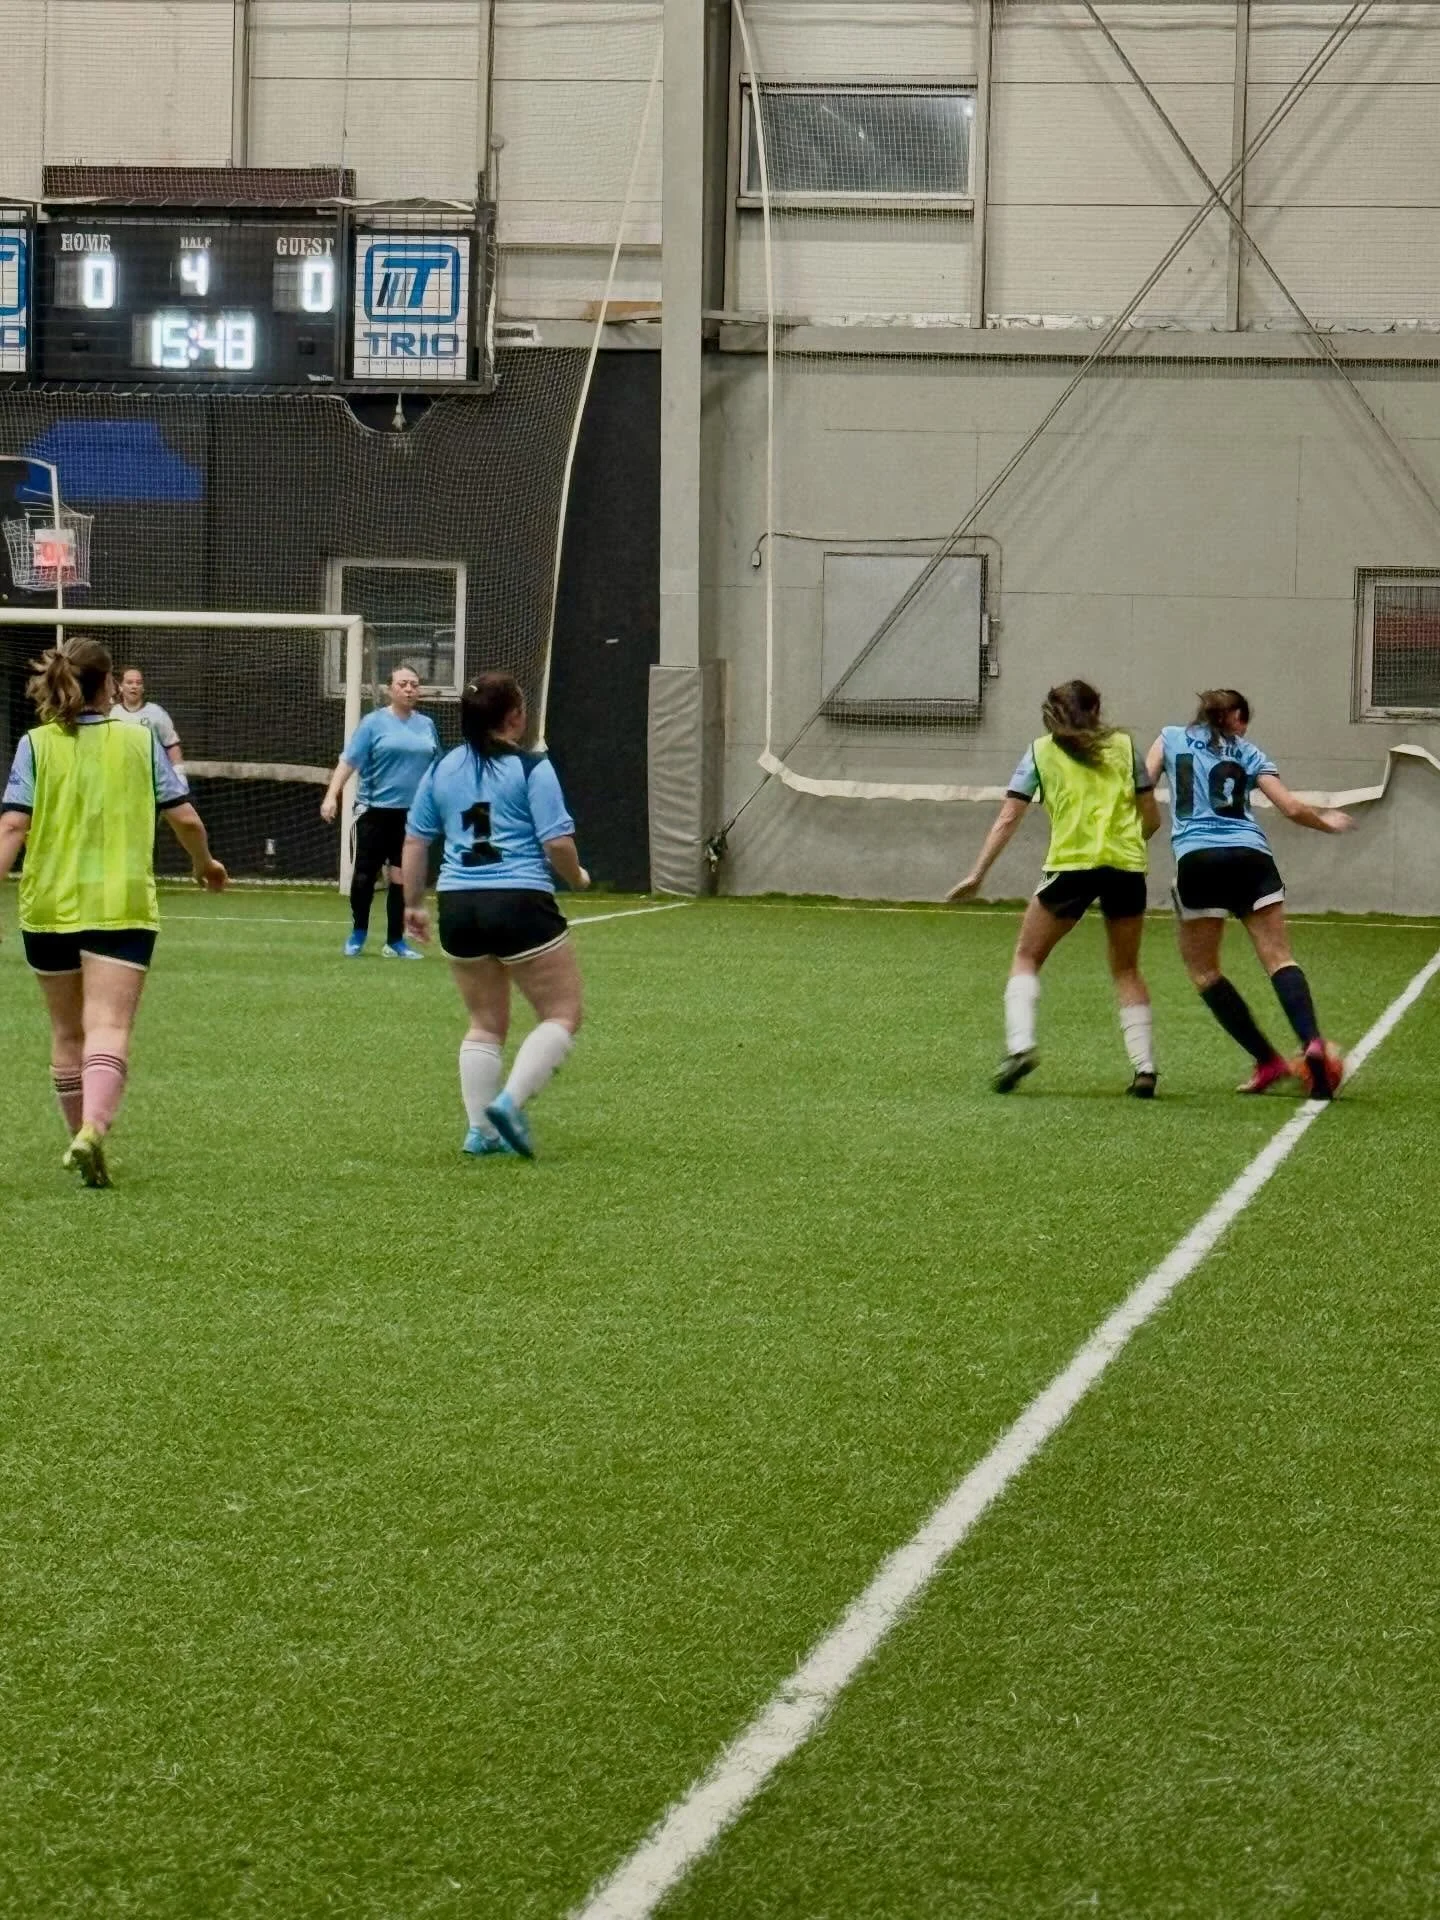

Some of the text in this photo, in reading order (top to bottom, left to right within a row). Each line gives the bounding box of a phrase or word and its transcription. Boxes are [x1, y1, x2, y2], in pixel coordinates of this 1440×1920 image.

[60, 233, 111, 252] HOME
[180, 236, 211, 249] HALF
[276, 236, 334, 257] GUEST
[84, 258, 113, 309] 0
[181, 254, 208, 296] 4
[302, 262, 334, 313] 0
[152, 316, 254, 369] 15:48
[363, 331, 459, 356] TRIO
[1175, 752, 1250, 820] 10
[460, 801, 503, 868] 1
